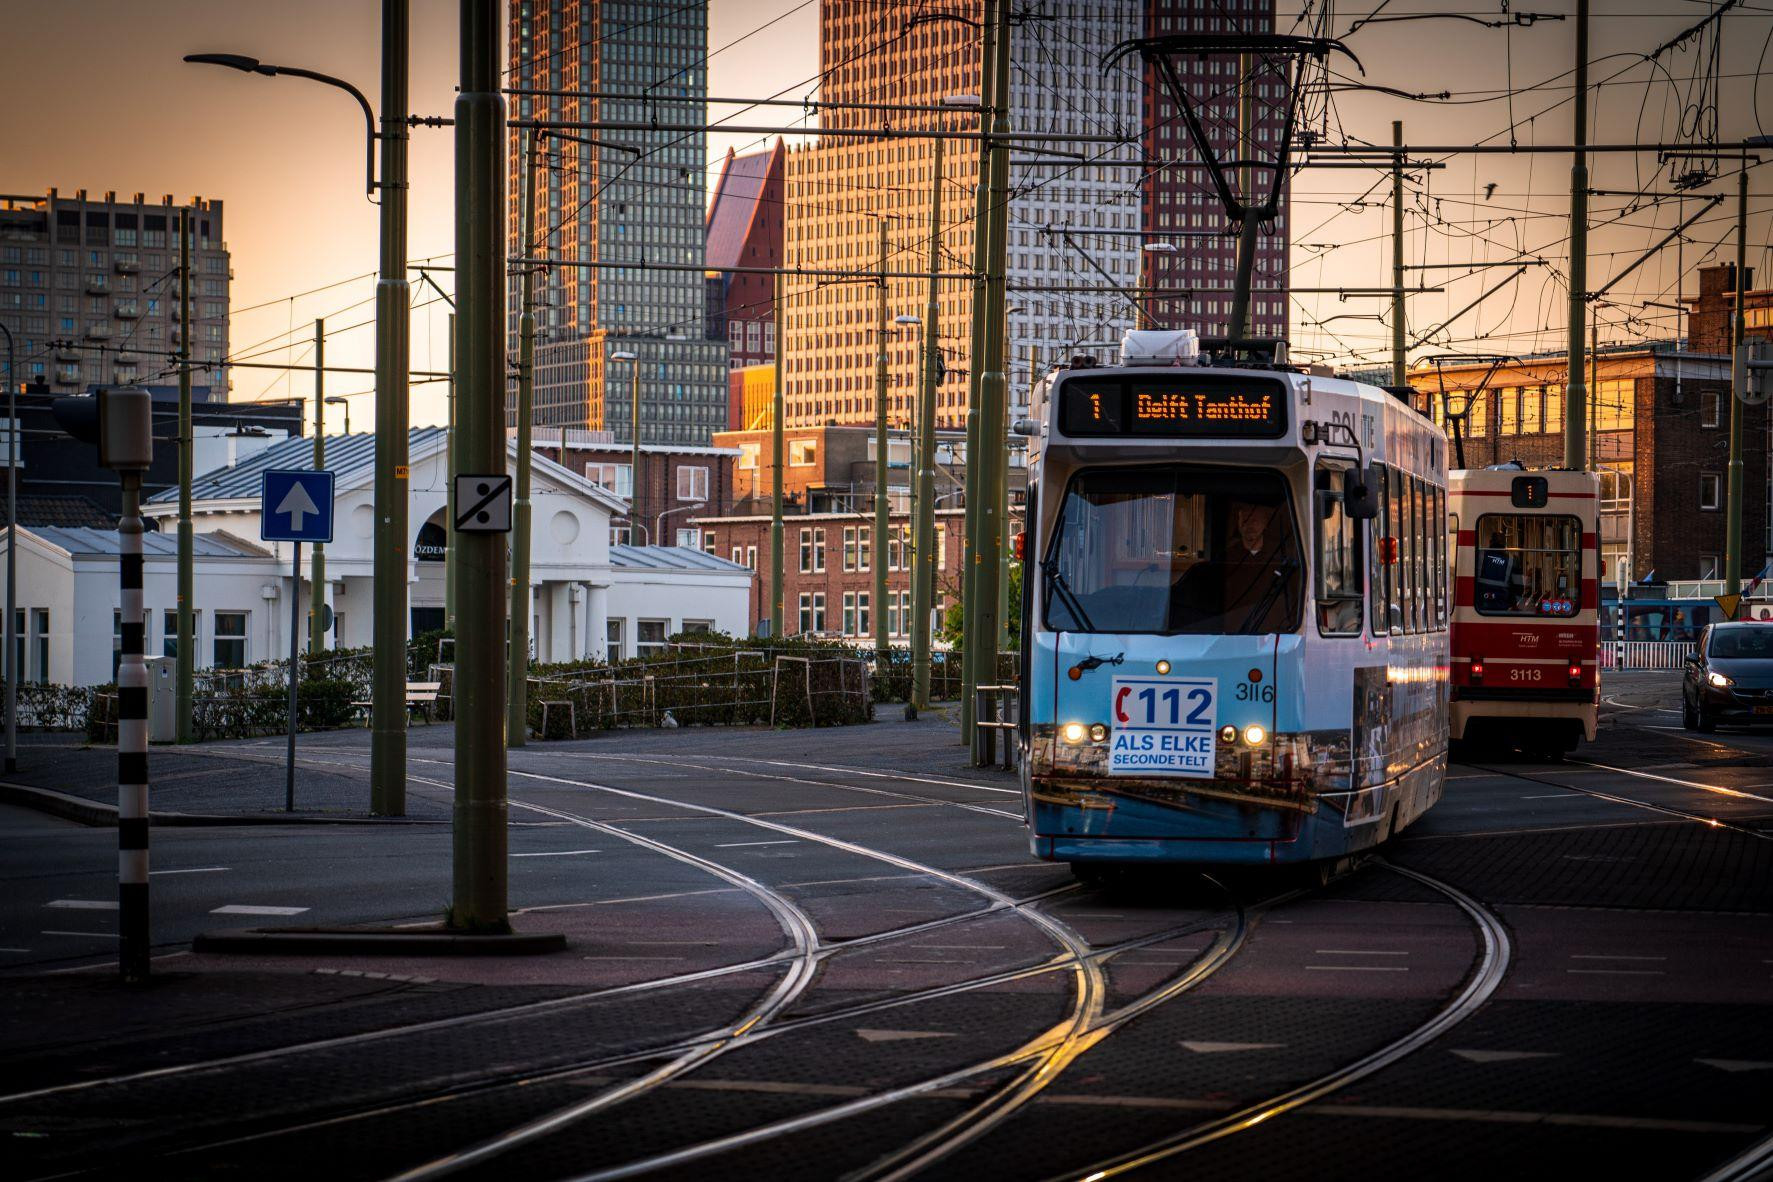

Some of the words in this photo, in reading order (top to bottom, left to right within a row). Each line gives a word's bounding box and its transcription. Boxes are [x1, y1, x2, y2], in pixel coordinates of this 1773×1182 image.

[1090, 394, 1100, 419] 1
[1138, 394, 1188, 418] Delft
[1195, 394, 1271, 419] Tanthof
[415, 544, 446, 554] ÖZDEM
[1520, 635, 1539, 643] HTM
[1510, 669, 1542, 681] 3113
[1236, 683, 1274, 703] 3116
[1139, 687, 1212, 725] 112
[1115, 735, 1154, 751] ALS
[1161, 735, 1211, 753] ELKE
[1113, 754, 1175, 765] SECONDE
[1178, 754, 1208, 766] TELT
